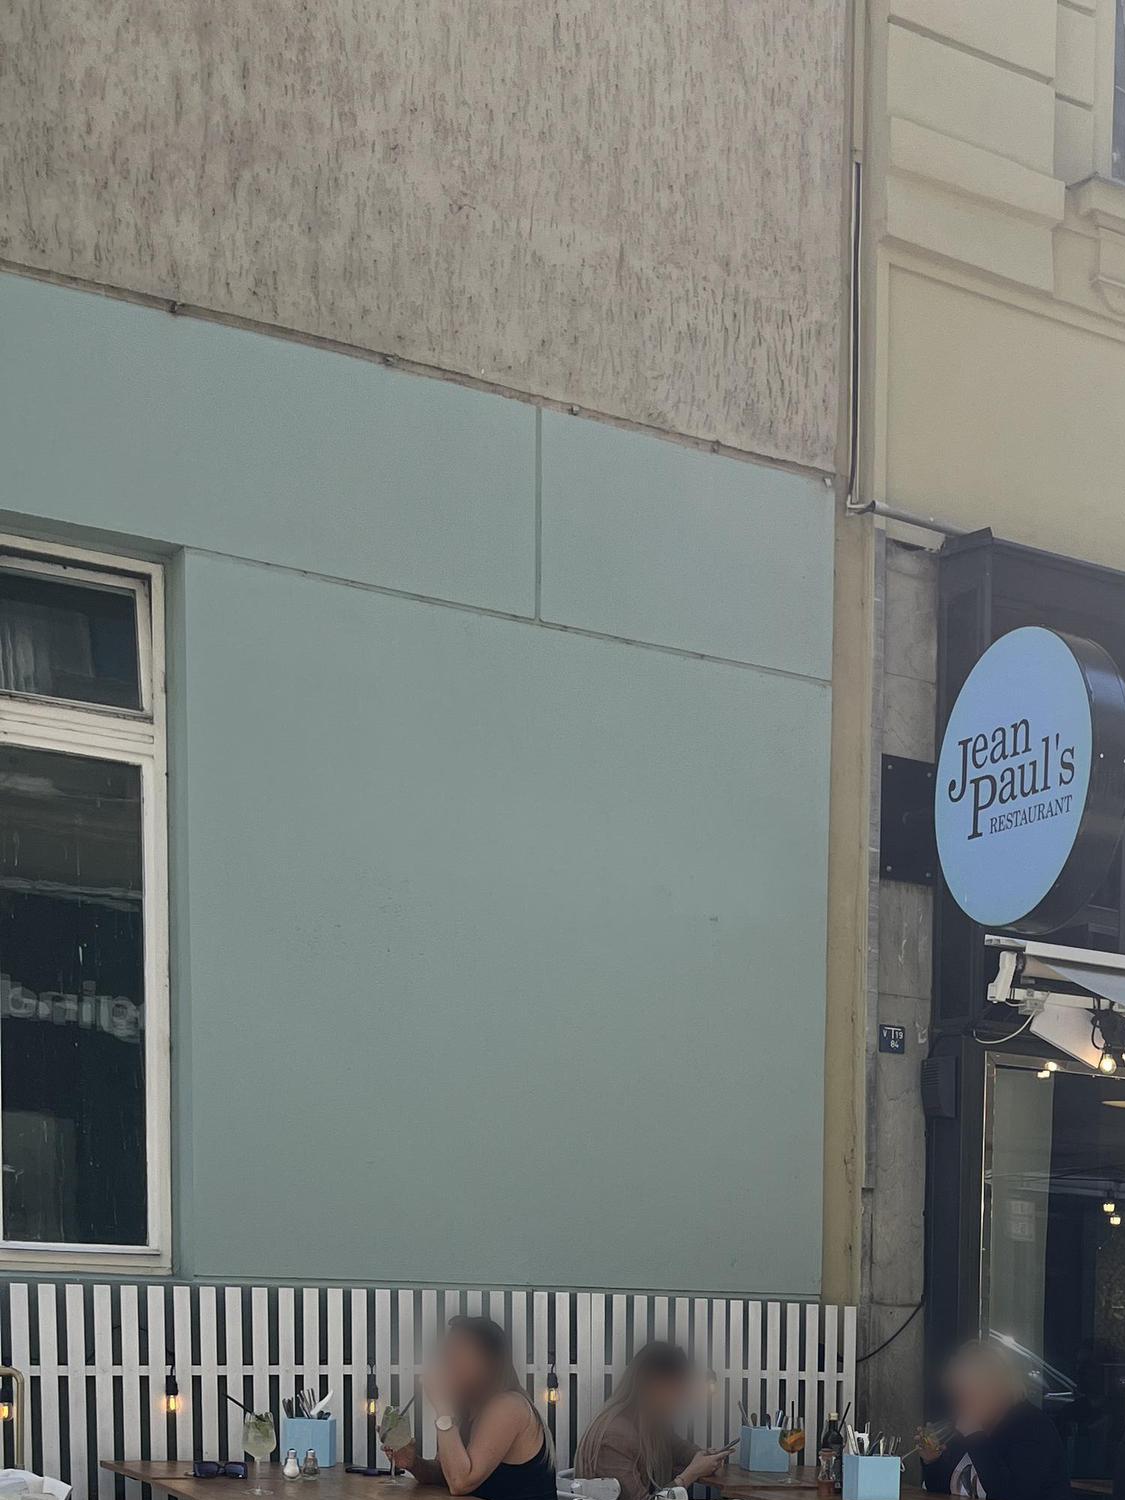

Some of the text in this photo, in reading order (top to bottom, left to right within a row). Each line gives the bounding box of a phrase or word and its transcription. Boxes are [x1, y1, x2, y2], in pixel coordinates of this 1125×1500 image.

[949, 718, 1032, 802] Jean
[967, 733, 1075, 840] Paul's
[990, 795, 1073, 834] RESTAURANT
